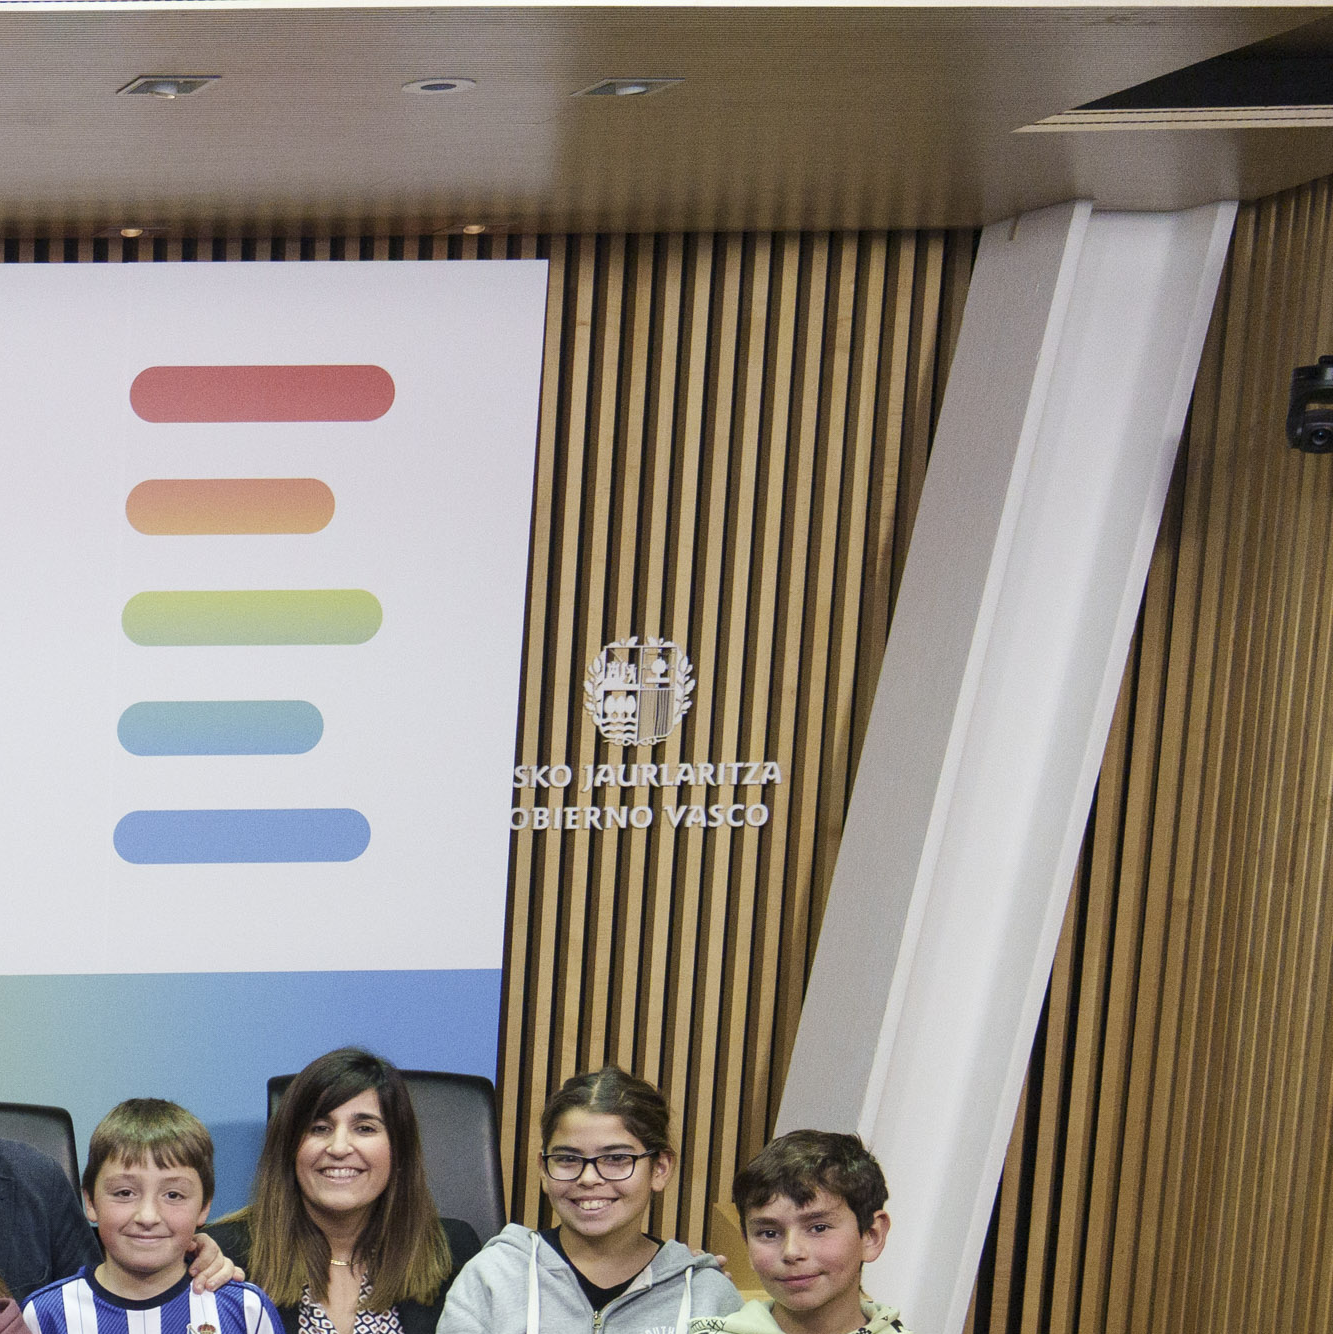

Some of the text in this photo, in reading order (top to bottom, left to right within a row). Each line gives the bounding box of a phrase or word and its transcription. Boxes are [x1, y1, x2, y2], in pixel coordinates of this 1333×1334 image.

[513, 762, 783, 793] SKO JAURLARITZA
[510, 803, 770, 831] OBIERNO VASCO
